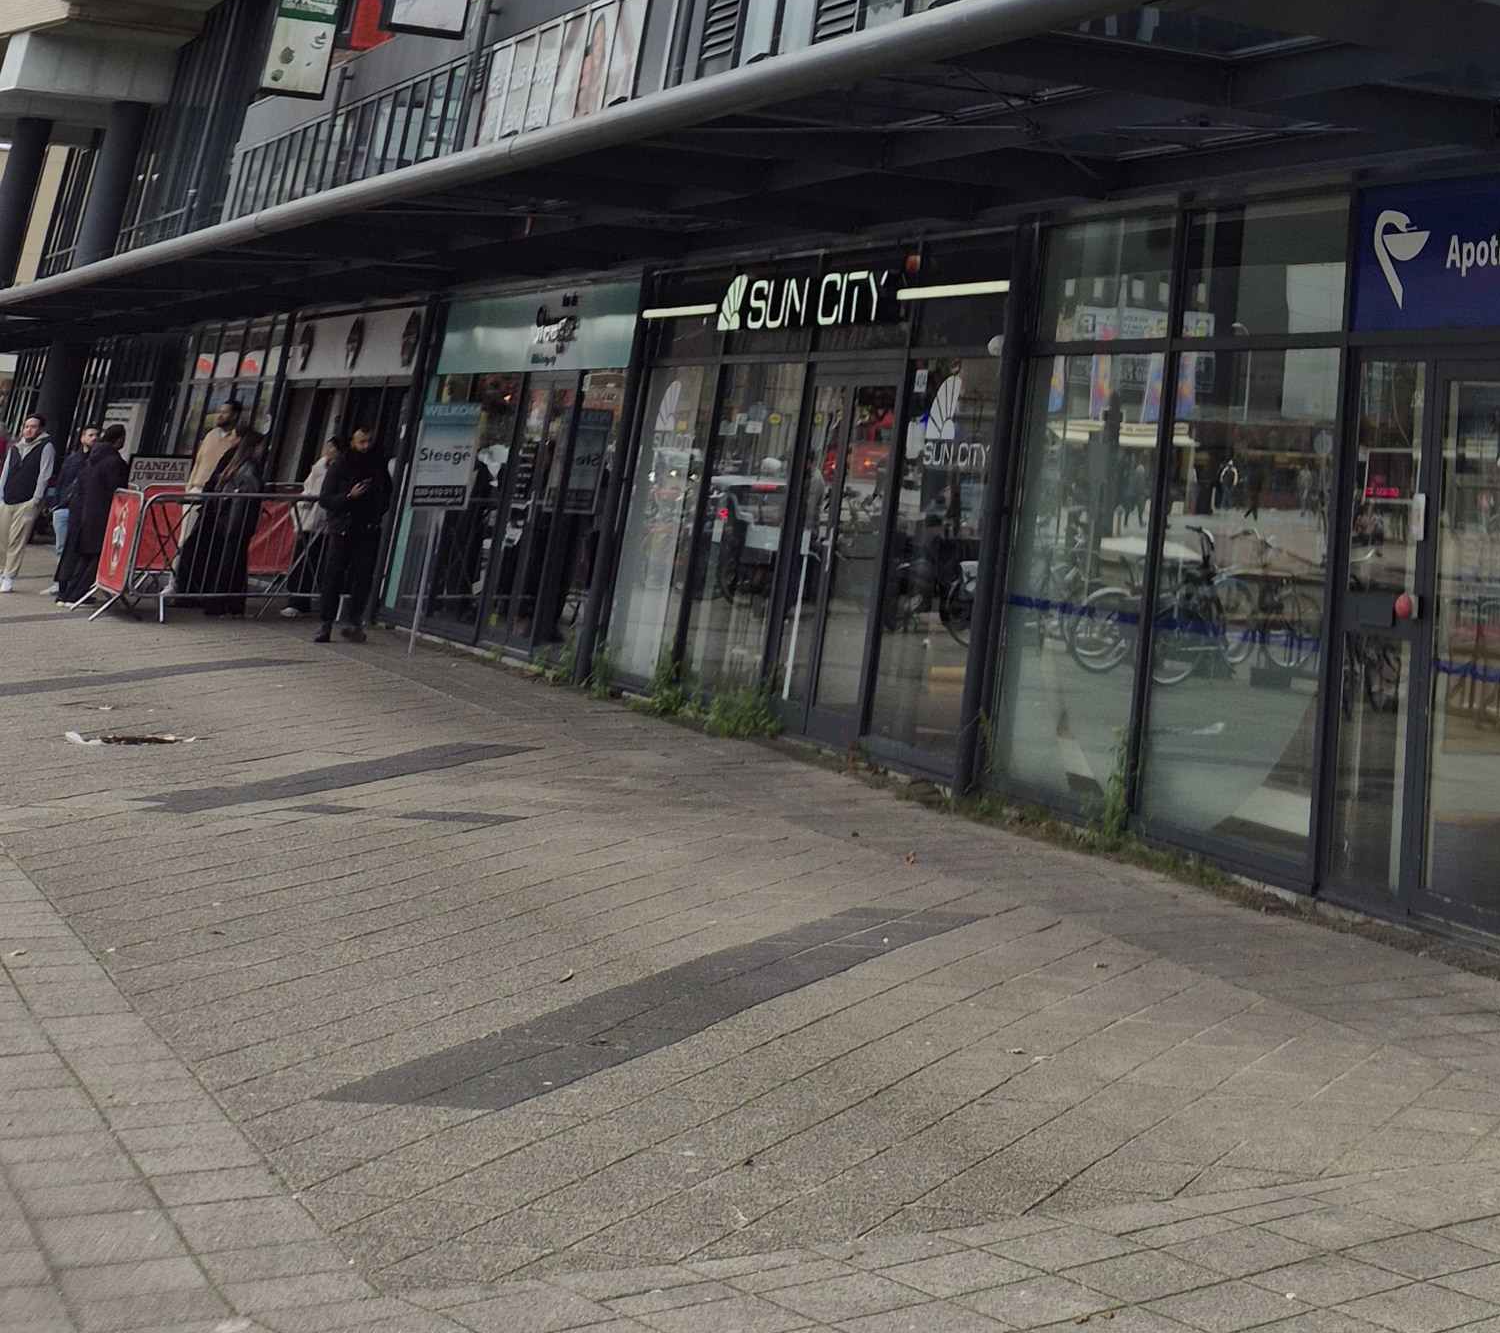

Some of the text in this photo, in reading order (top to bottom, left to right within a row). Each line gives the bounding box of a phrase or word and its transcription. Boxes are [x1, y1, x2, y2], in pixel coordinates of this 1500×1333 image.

[746, 270, 889, 329] SUN CITY
[134, 460, 190, 472] GANPAT
[923, 441, 991, 468] SUN CITY
